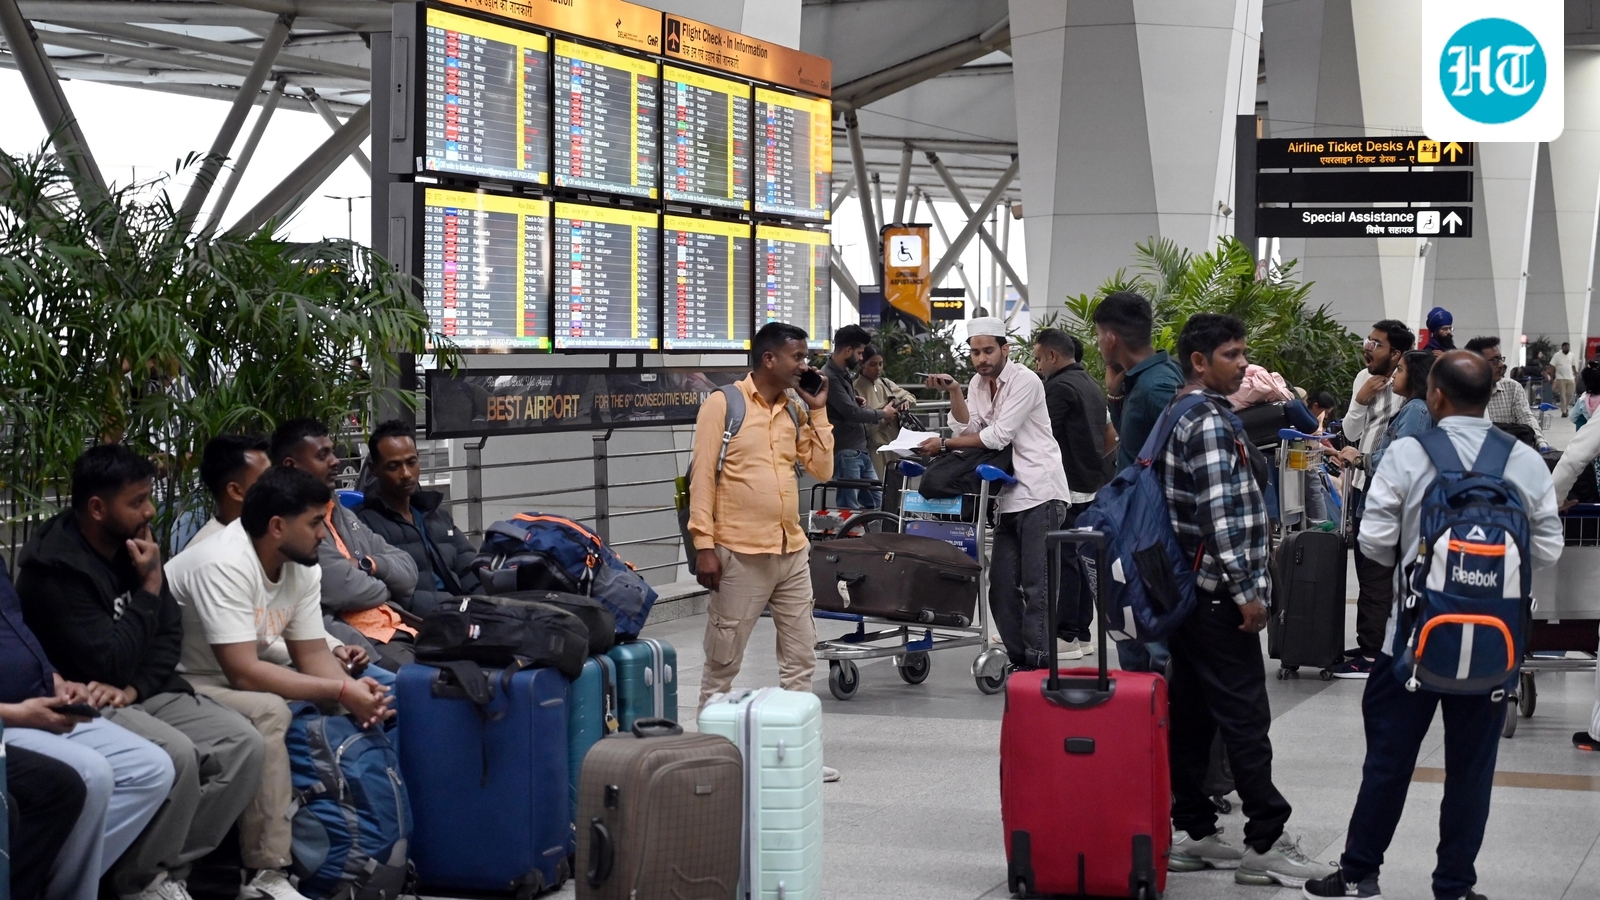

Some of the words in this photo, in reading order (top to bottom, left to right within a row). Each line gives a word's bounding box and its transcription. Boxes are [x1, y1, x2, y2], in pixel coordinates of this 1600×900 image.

[682, 23, 701, 41] Flight
[702, 28, 722, 46] Check
[726, 35, 733, 49] In
[734, 38, 768, 59] Information
[1288, 141, 1324, 153] Airline
[1328, 141, 1362, 152] Ticket
[1366, 140, 1403, 152] Desks
[1406, 140, 1415, 151] A
[1356, 155, 1376, 164] टिकट
[1302, 212, 1345, 224] Special
[1348, 211, 1414, 223] Assistance
[1366, 225, 1385, 234] विशेष
[1388, 226, 1414, 234] सहायक
[487, 395, 522, 420] BEST
[524, 394, 580, 420] AIRPORT
[594, 395, 609, 409] FOR
[611, 394, 624, 408] THE
[634, 392, 680, 407] CONSECUTIVE
[680, 392, 698, 405] YEAR
[1452, 566, 1497, 587] Reebok
